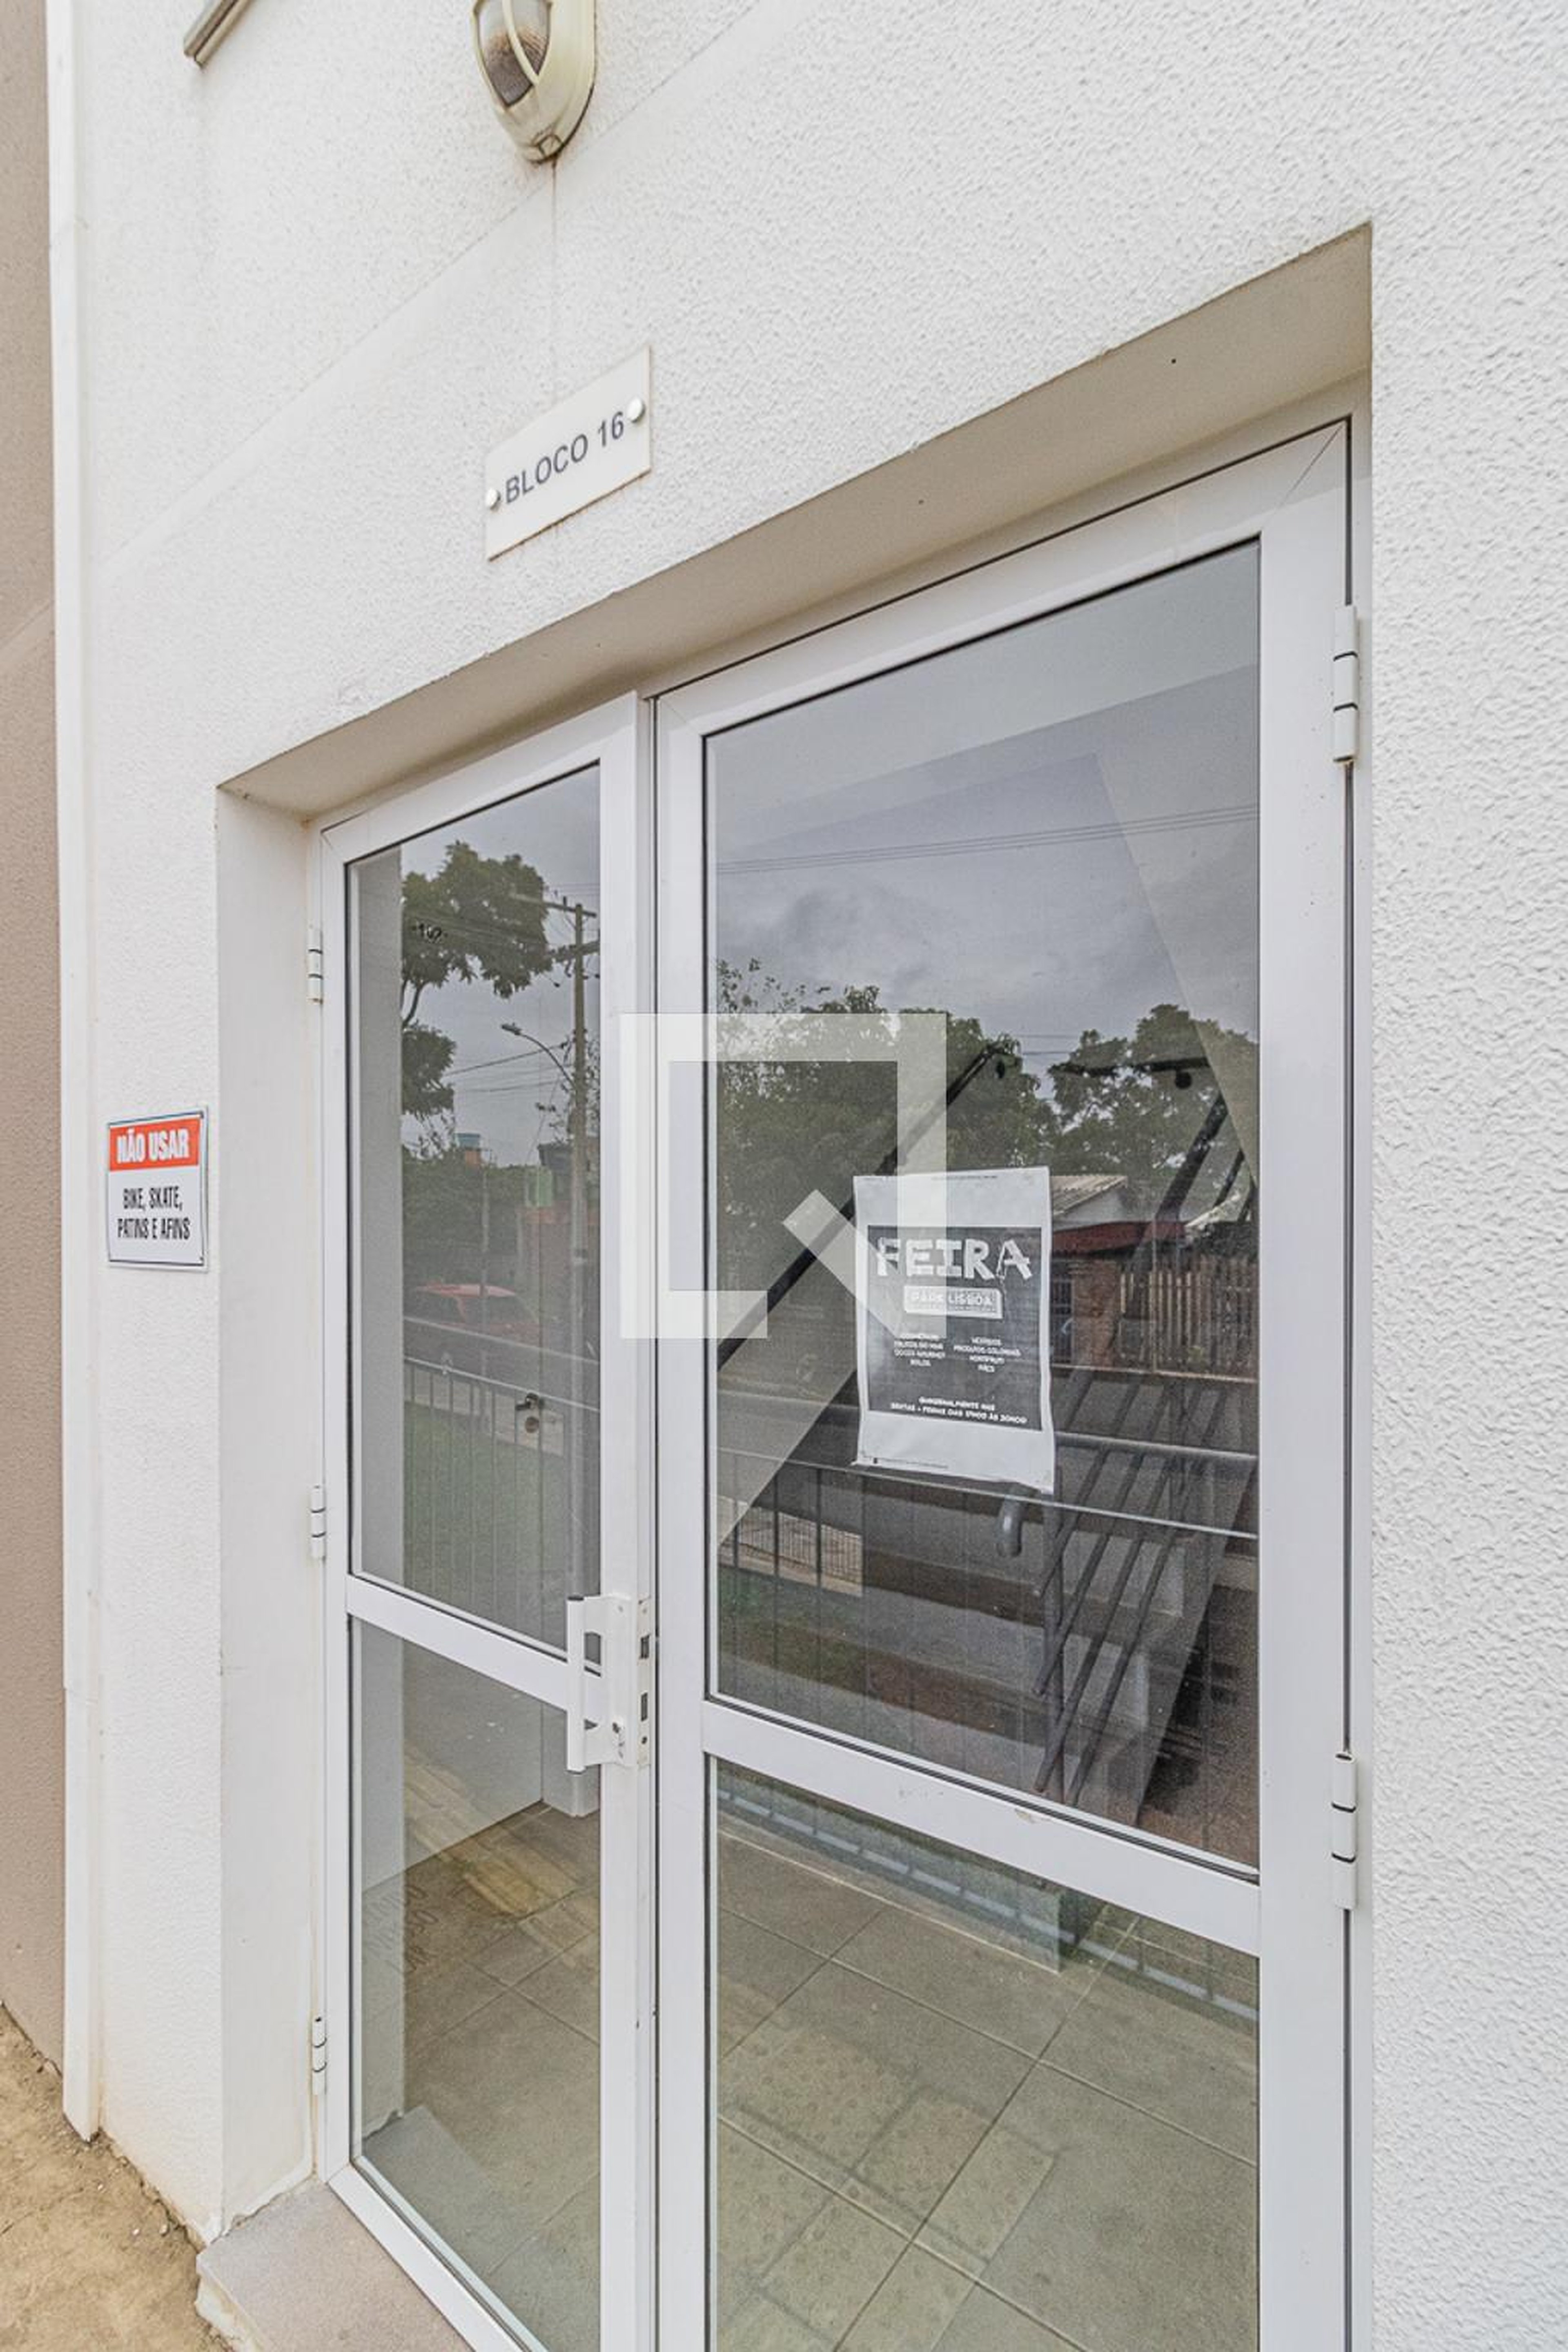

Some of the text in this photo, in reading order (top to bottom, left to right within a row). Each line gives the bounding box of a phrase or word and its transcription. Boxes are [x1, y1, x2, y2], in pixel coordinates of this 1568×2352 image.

[506, 411, 624, 503] BLOCO 16
[117, 1128, 189, 1164] NÃO USAR
[124, 1185, 183, 1212] BIKE, SKATE,
[118, 1217, 191, 1241] PATINS E AFINS
[877, 1237, 1033, 1280] FEIRA
